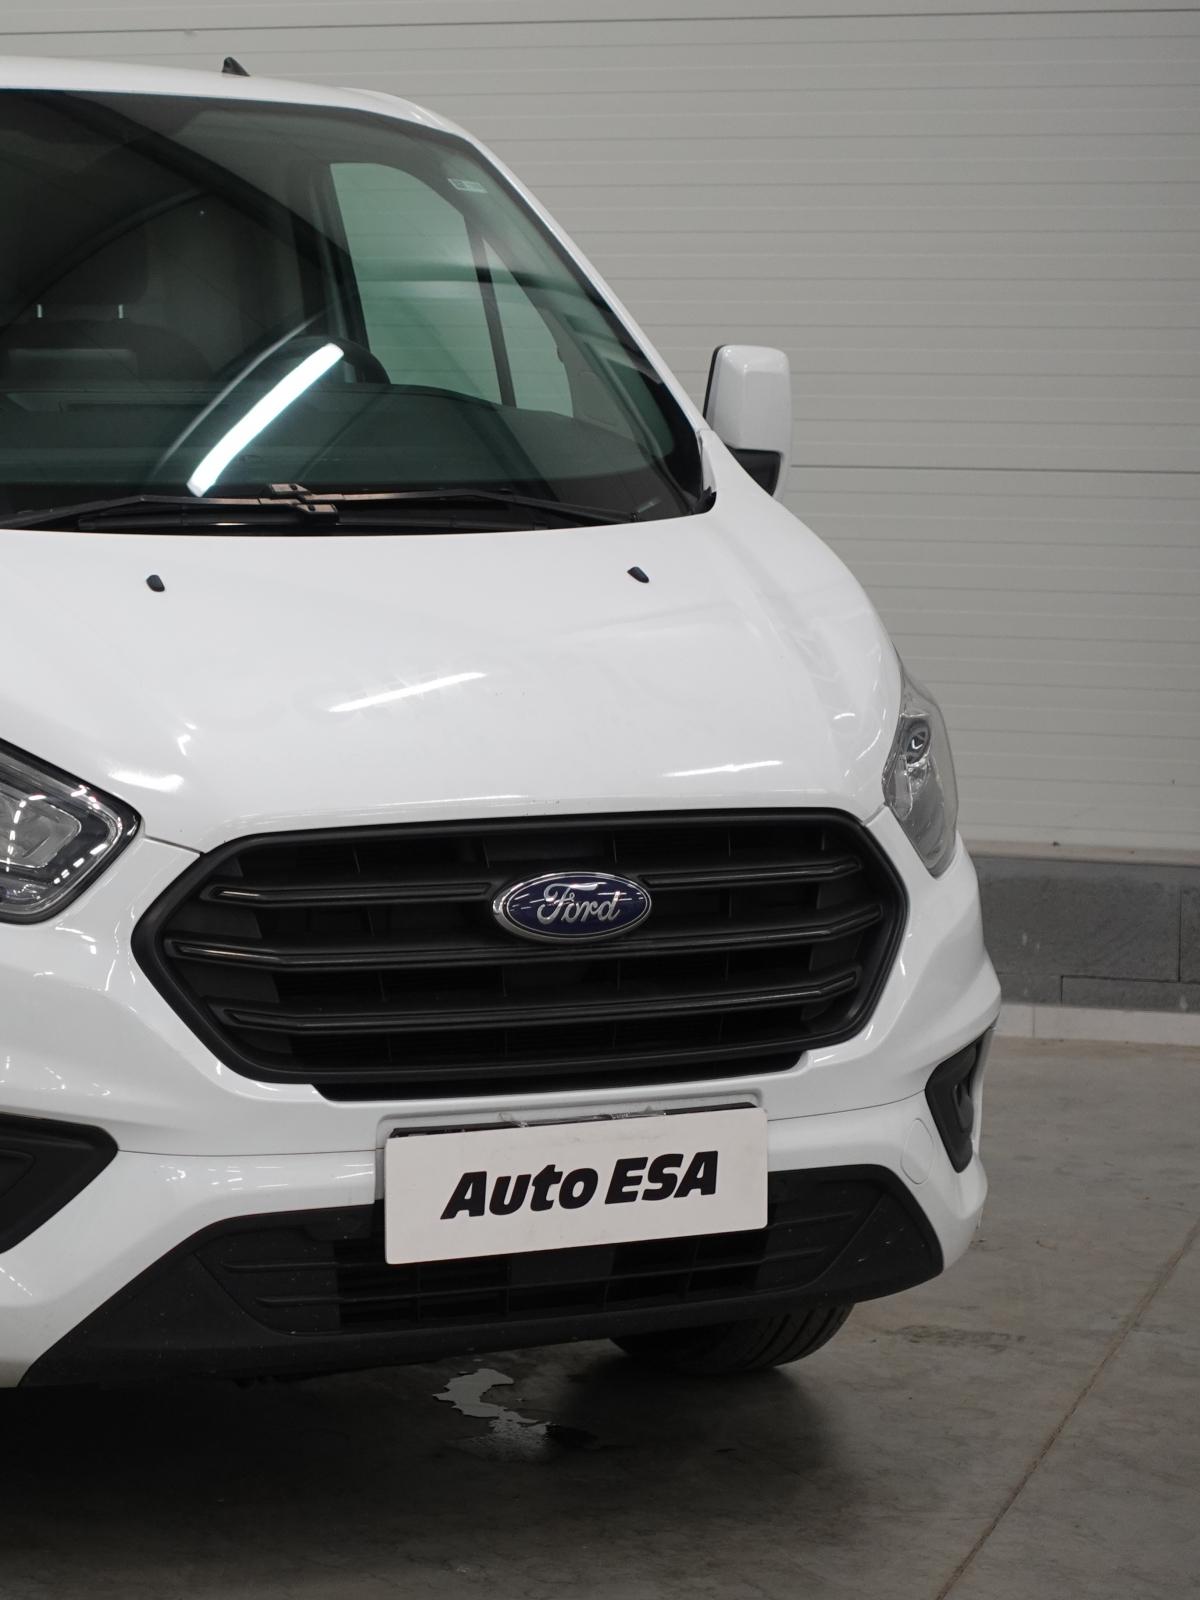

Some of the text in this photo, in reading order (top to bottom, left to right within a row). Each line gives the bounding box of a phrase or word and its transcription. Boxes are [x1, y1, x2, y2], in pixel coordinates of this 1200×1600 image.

[536, 882, 621, 924] Ford
[440, 1150, 719, 1220] Auto ESA
